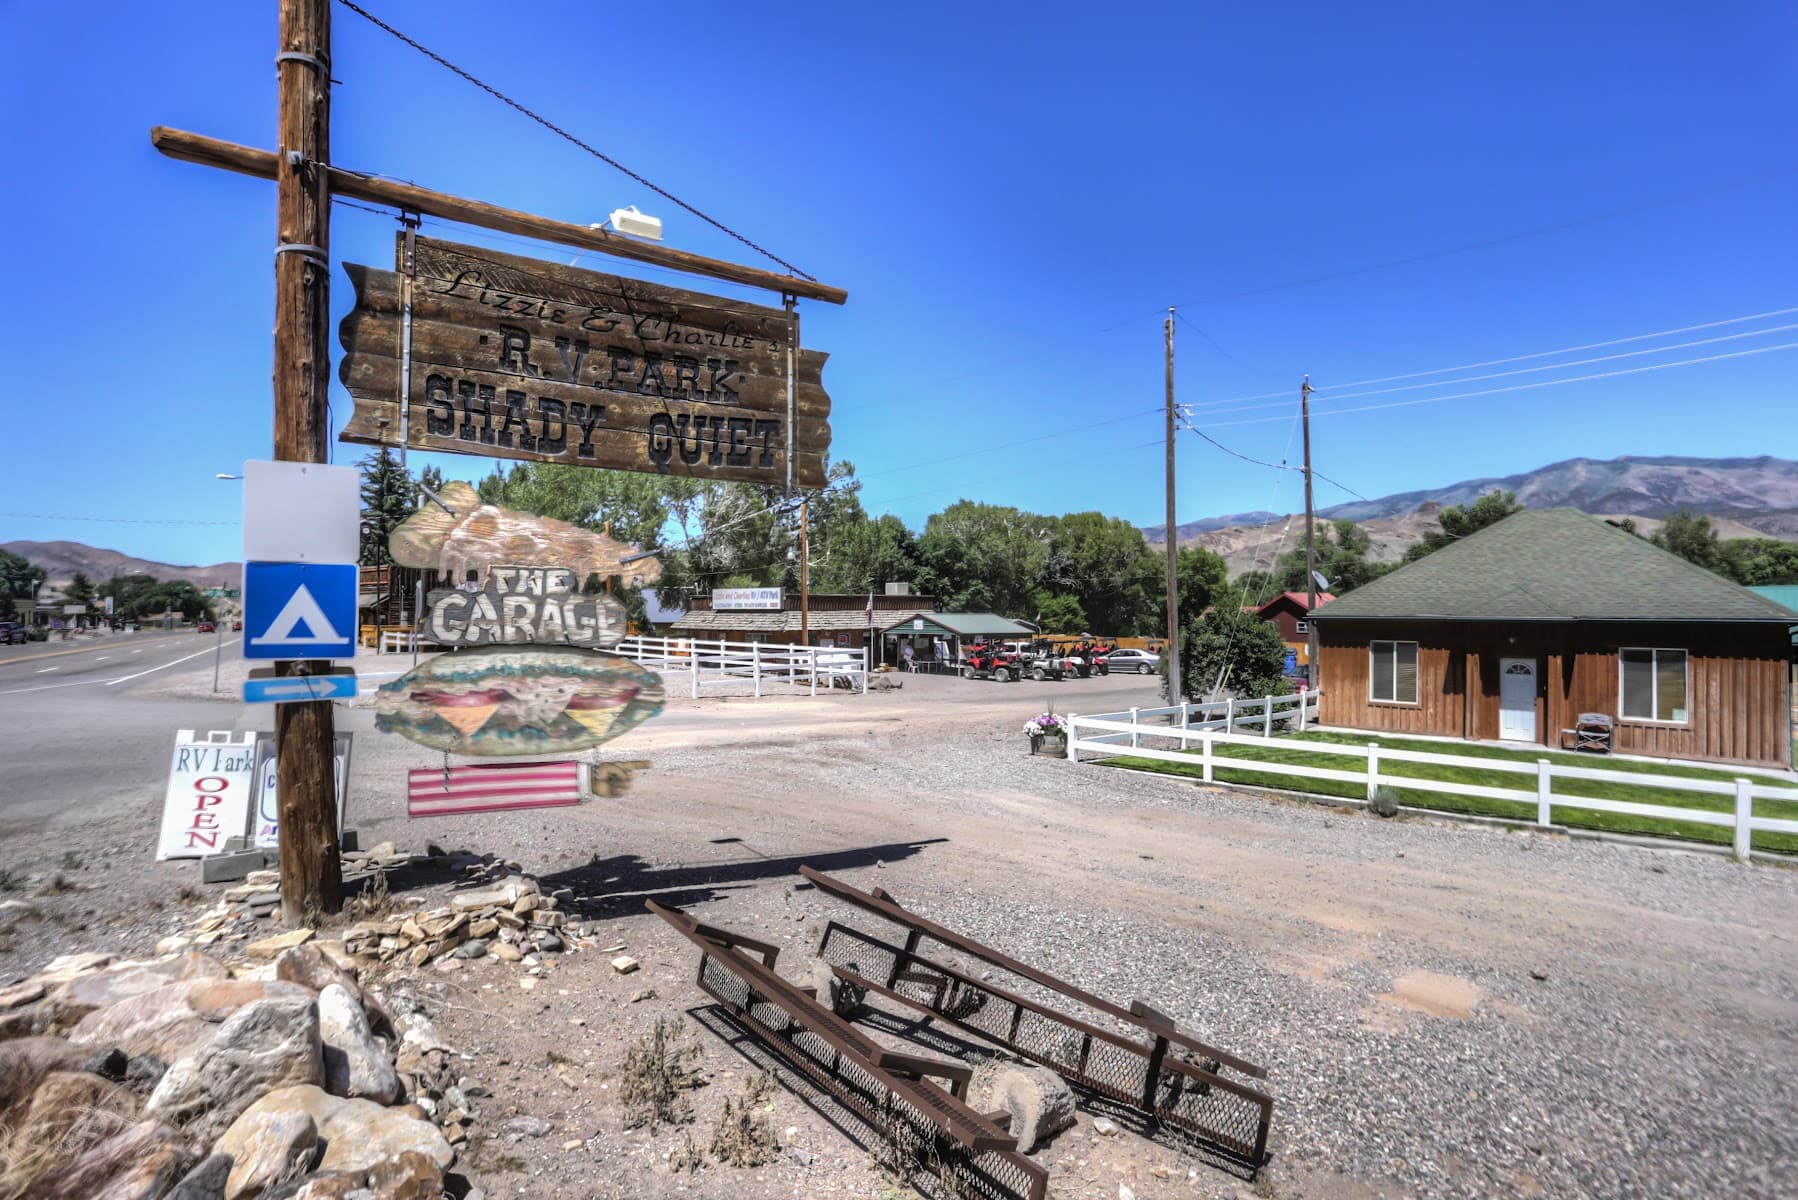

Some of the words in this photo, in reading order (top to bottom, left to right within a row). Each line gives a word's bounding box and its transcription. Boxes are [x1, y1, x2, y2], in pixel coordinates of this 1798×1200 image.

[429, 270, 567, 325] Lizzie
[581, 306, 620, 333] &
[426, 373, 607, 459] SHADY
[648, 411, 782, 475] QUIET
[491, 567, 571, 597] THE
[432, 593, 625, 643] GARAGE
[176, 747, 209, 772] RV
[183, 775, 230, 849] OPEN
